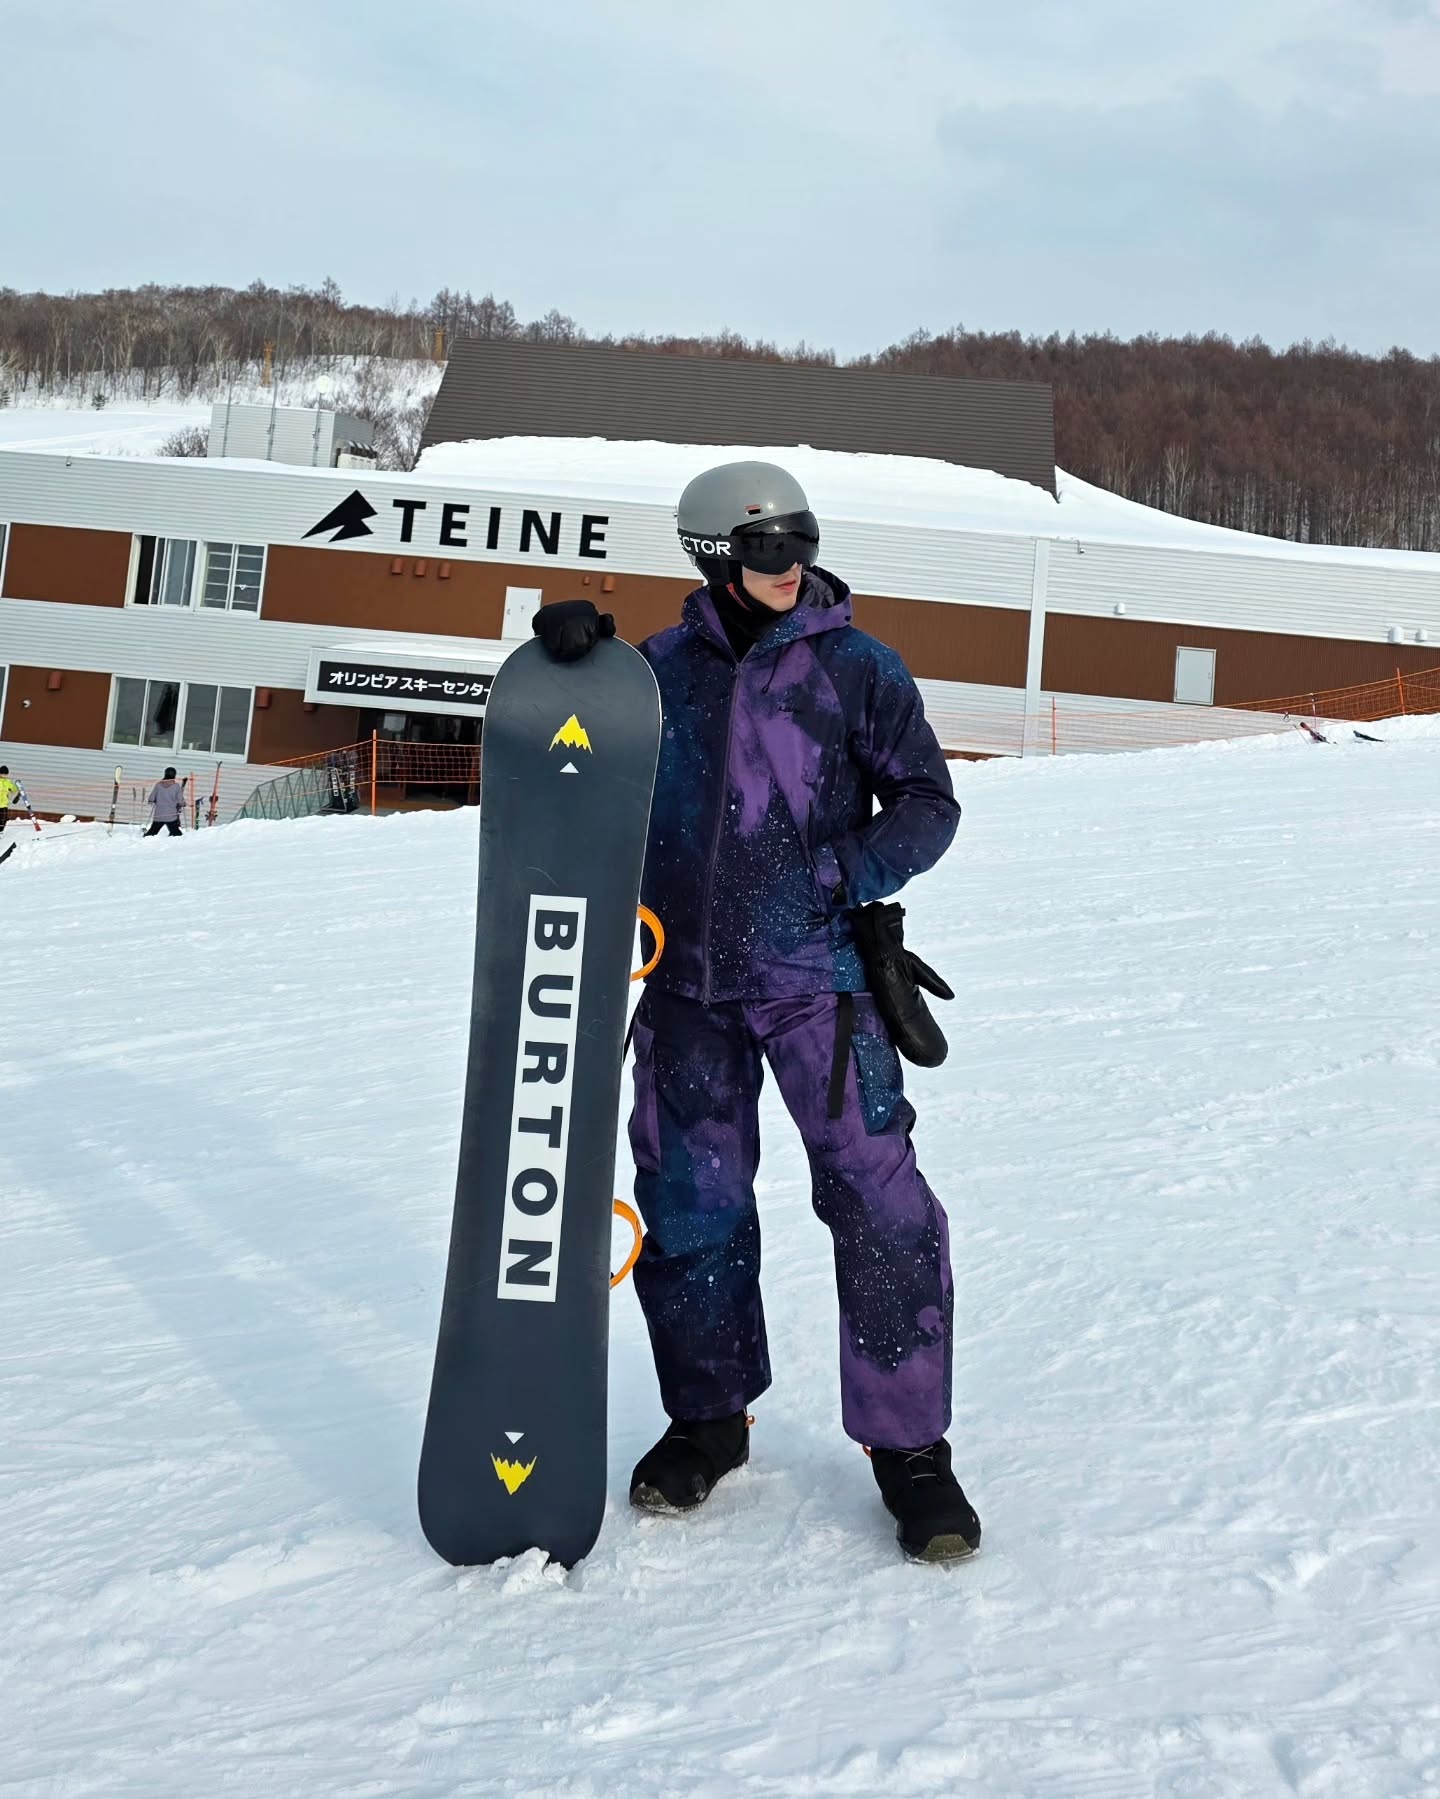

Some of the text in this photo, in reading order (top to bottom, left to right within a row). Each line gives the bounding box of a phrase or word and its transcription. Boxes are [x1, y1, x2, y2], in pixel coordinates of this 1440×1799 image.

[392, 498, 609, 559] TEINE
[680, 535, 732, 556] CTOR
[505, 909, 579, 1287] BURTON
